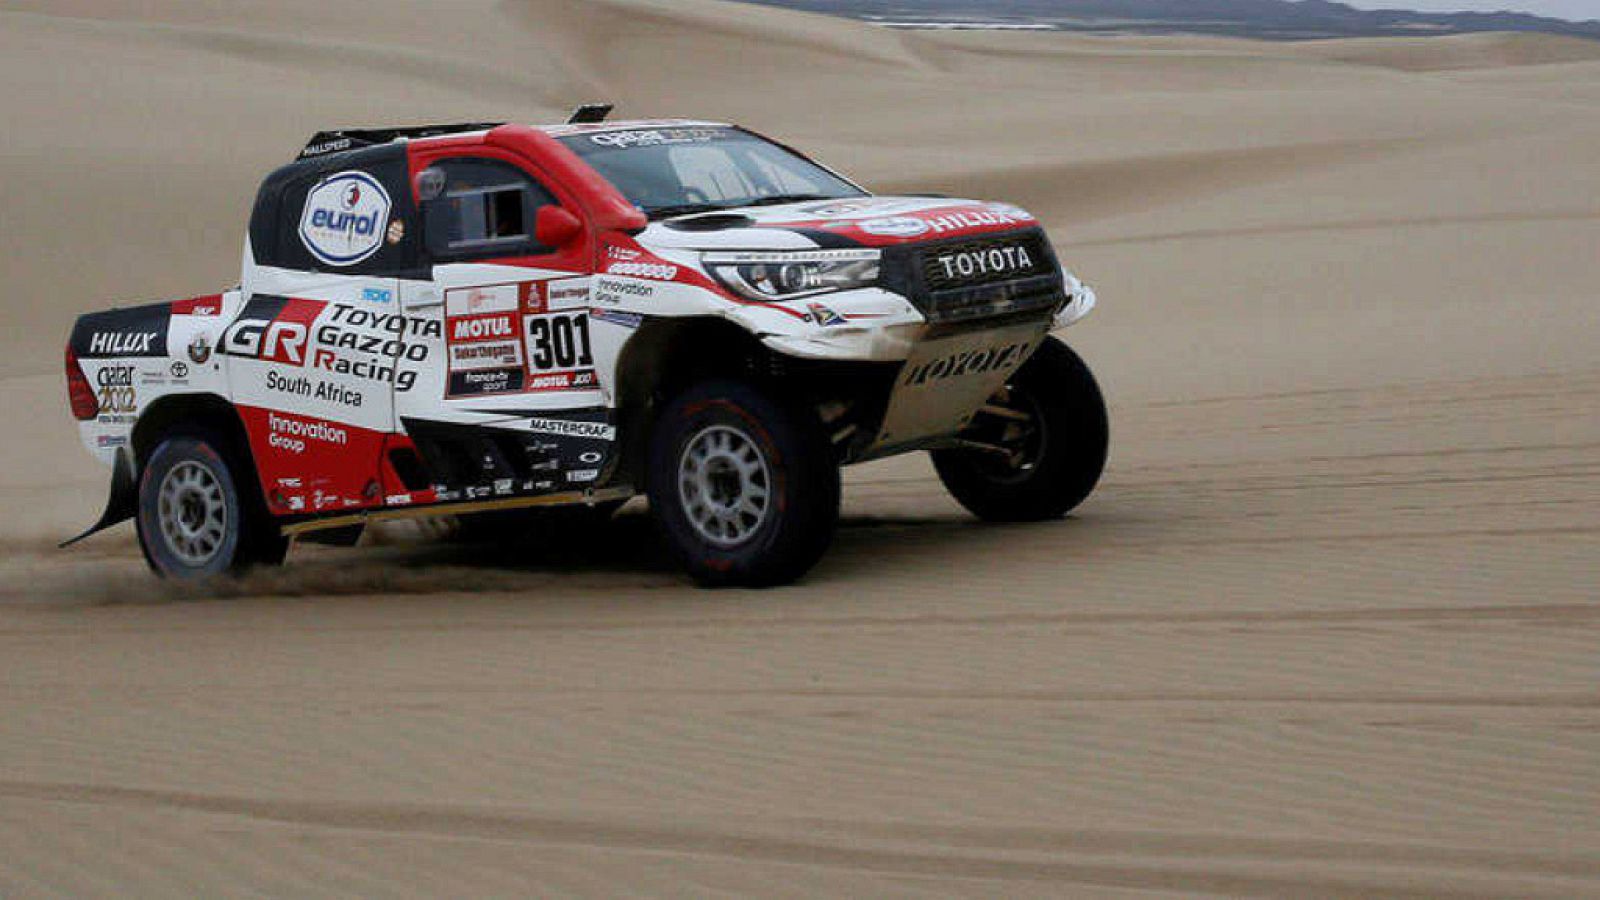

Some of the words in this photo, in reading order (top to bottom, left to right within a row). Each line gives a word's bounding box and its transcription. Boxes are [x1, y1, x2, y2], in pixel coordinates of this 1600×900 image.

[312, 207, 380, 236] eurol
[939, 246, 1034, 279] TOYOTA
[331, 304, 441, 338] TOYOTA
[454, 317, 513, 340] MOTUL
[90, 332, 158, 353] HILUX
[225, 320, 308, 363] GR
[317, 326, 429, 361] GAZOO
[530, 313, 594, 370] 301
[313, 349, 418, 392] Racing
[266, 370, 312, 397] South
[314, 381, 362, 407] Africa
[268, 412, 348, 445] Innovation
[269, 433, 306, 454] Group
